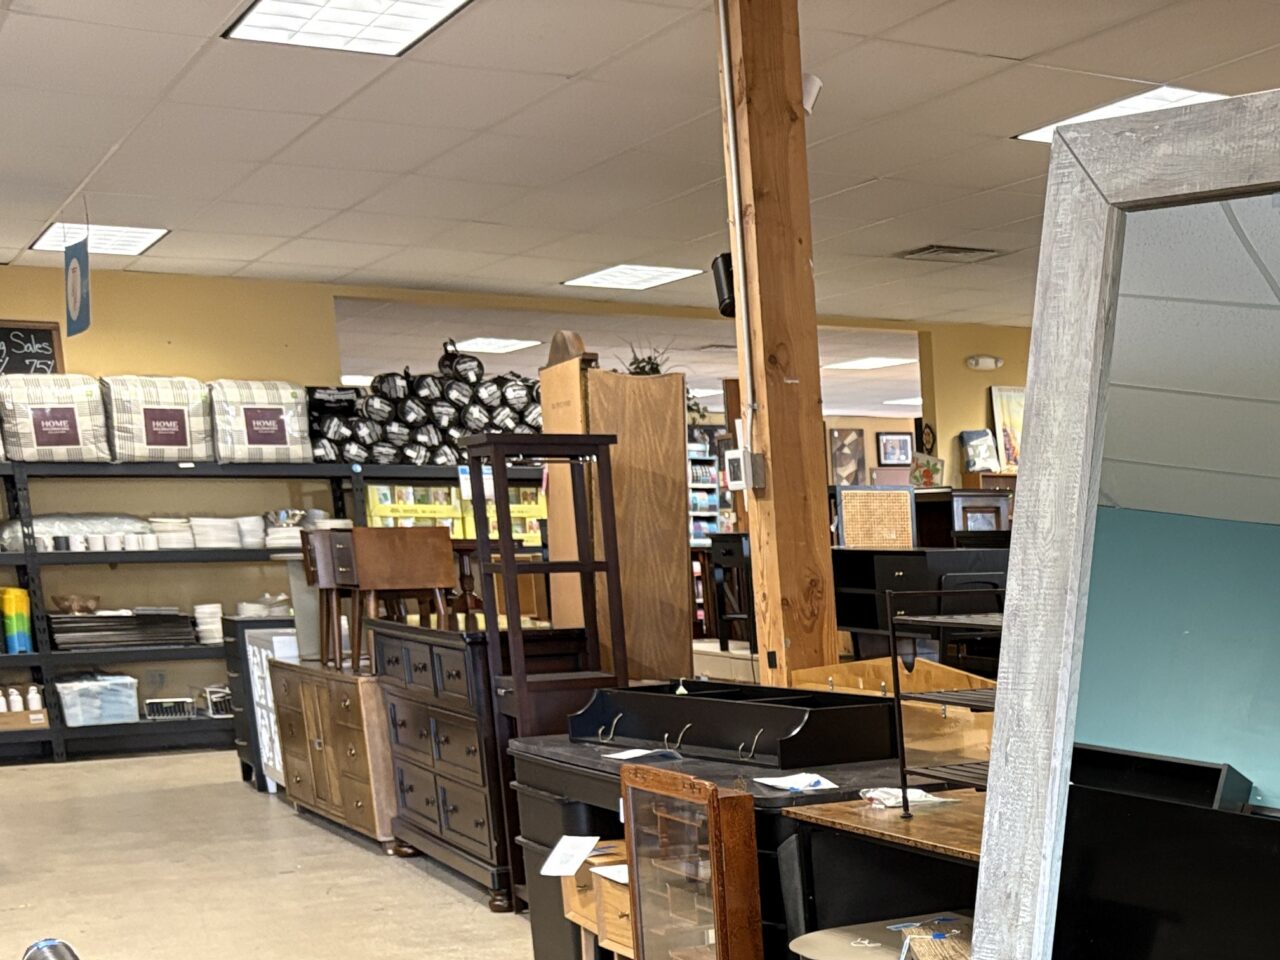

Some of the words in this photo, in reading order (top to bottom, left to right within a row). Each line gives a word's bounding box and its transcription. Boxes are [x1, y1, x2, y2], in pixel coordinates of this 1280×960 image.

[10, 331, 52, 355] Sales
[41, 419, 69, 428] HOME
[151, 420, 179, 428] HOME
[252, 419, 277, 428] HOME
